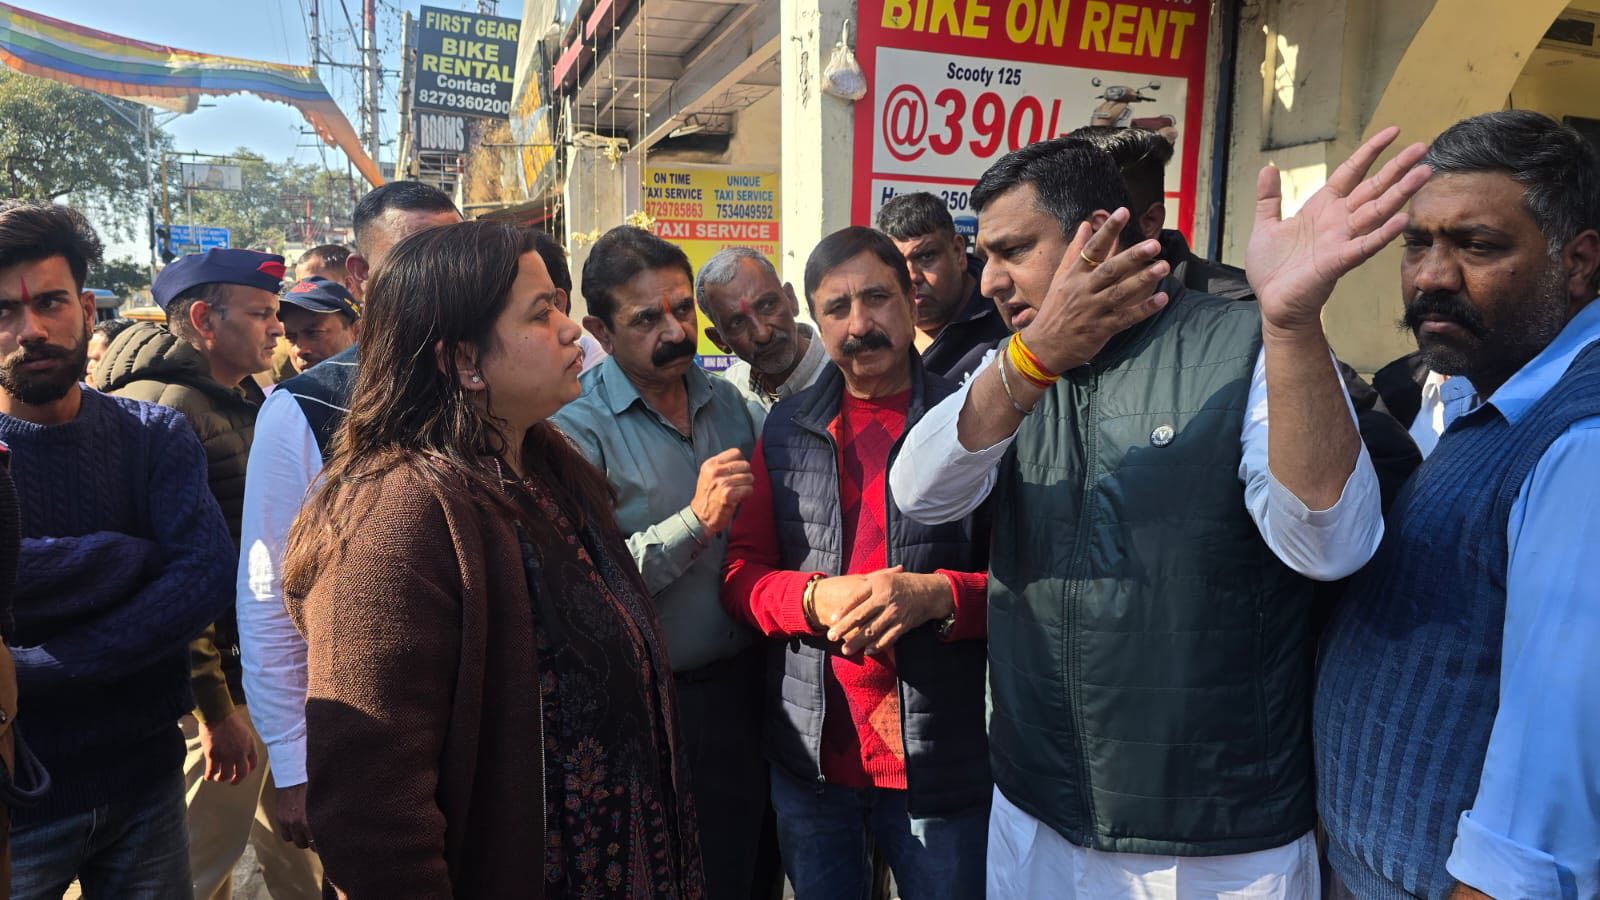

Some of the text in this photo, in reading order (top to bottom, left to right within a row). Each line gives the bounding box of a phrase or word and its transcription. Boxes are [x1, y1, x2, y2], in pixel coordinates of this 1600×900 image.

[425, 11, 518, 42] FIRST GEAR
[881, 0, 1196, 60] BIKE ON RENT
[442, 37, 500, 62] BIKE
[422, 54, 514, 83] RENTAL
[946, 62, 1022, 87] Scooty 125
[436, 74, 497, 95] Contact
[419, 89, 510, 114] 8279360200
[420, 114, 464, 151] ROOMS
[654, 173, 691, 185] ON TIME
[727, 176, 760, 187] UNIQUE
[665, 188, 703, 200] SERVICE
[714, 190, 773, 201] TAXI SERVICE
[717, 204, 773, 219] 7534049592
[653, 222, 770, 239] TAXI SERVICE
